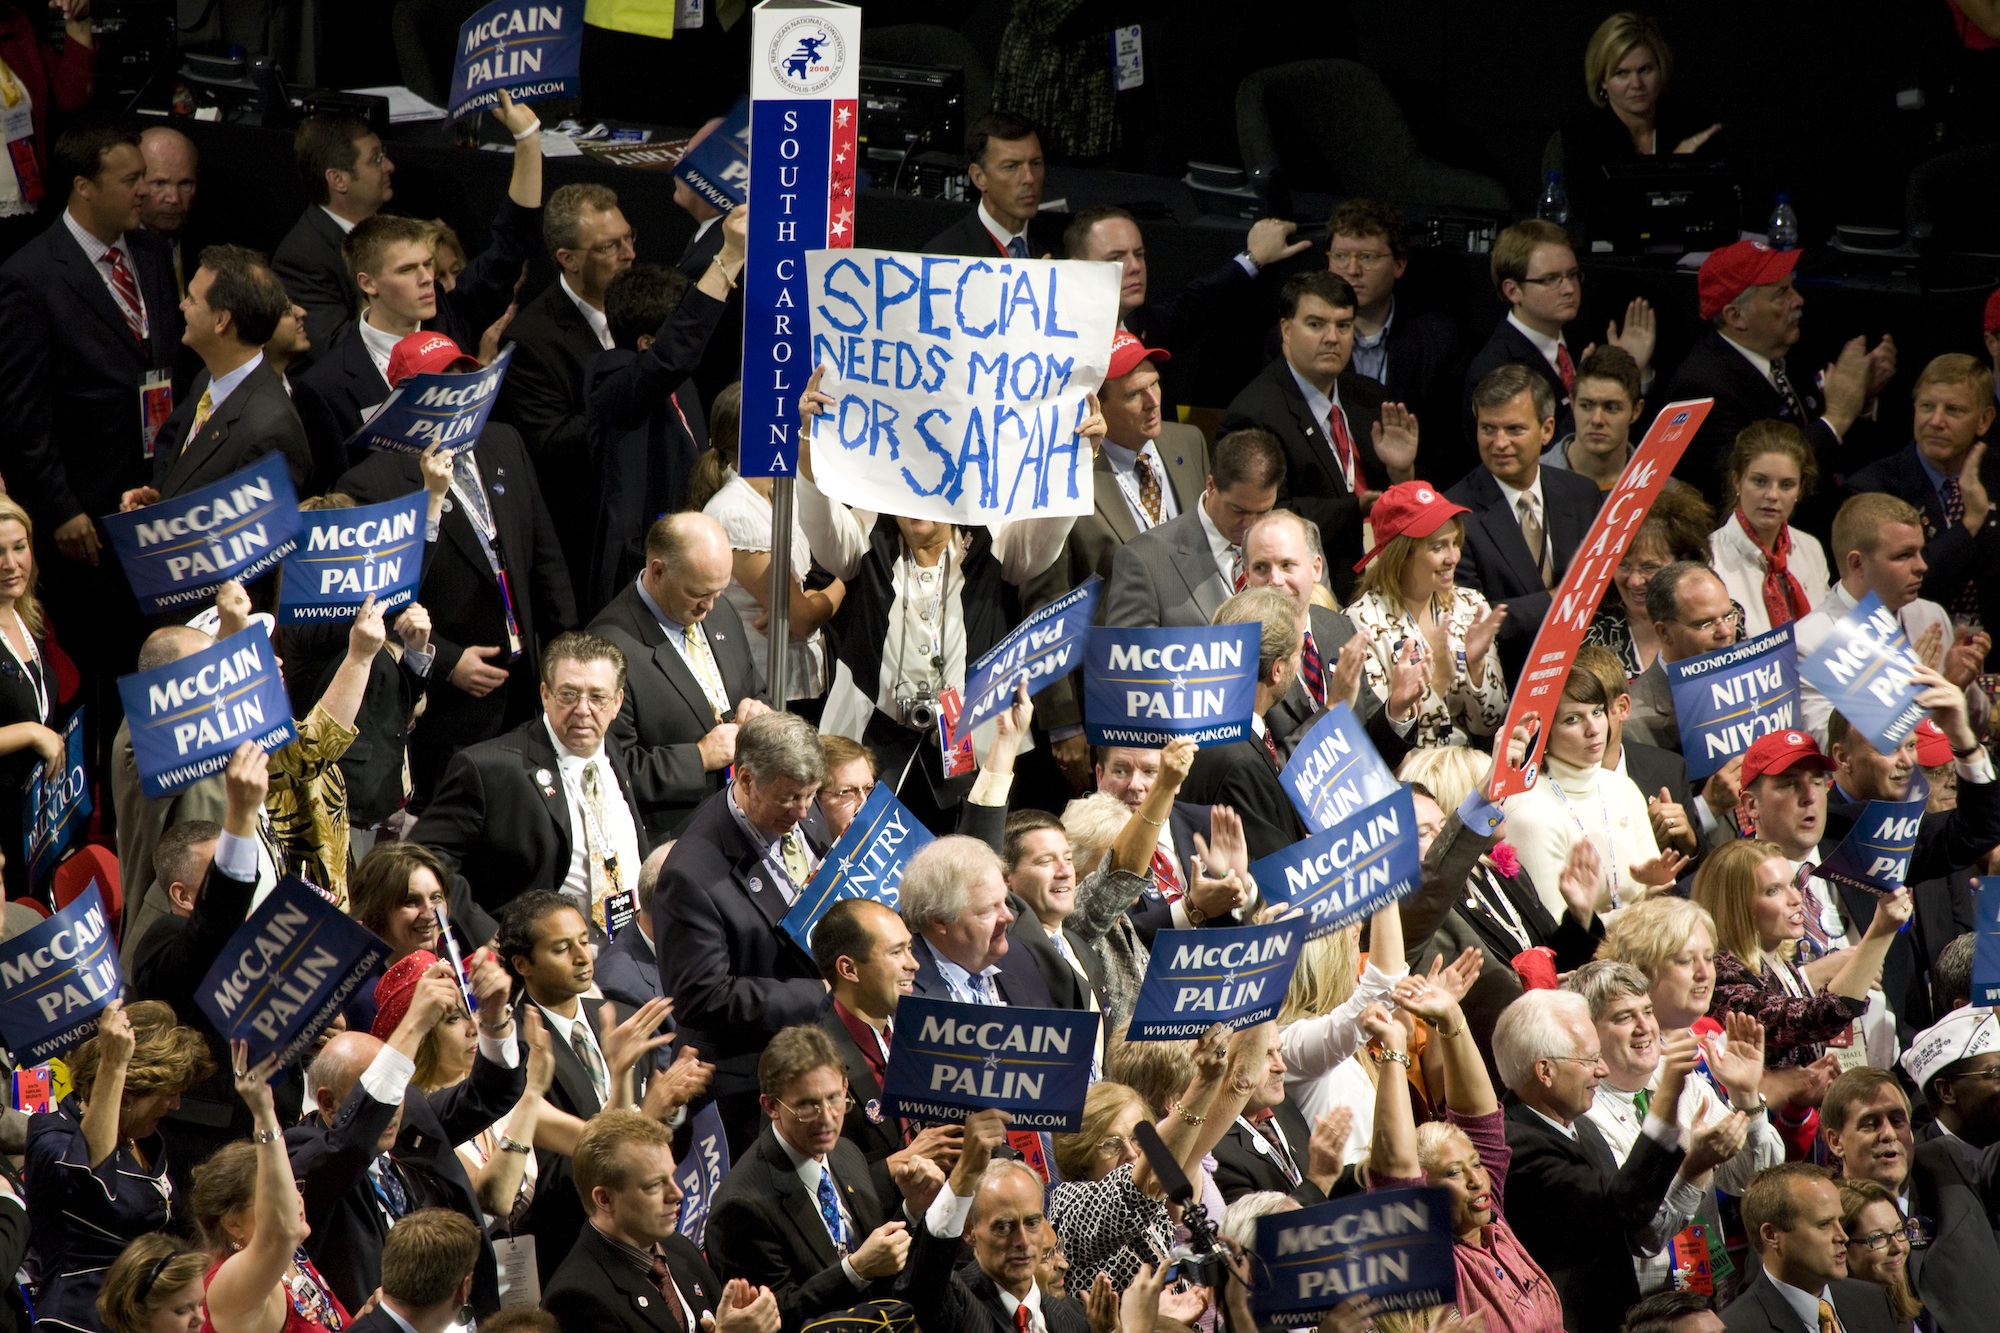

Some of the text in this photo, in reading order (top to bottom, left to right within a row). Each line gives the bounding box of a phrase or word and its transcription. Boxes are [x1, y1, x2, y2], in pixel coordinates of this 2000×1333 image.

[464, 5, 563, 55] McCAIN
[770, 18, 844, 63] REPUBLICAN NATIONAL CONVENTION
[466, 47, 542, 91] PALIN
[829, 66, 841, 81] PAUL
[769, 111, 799, 471] SOUTH CAROLINA
[416, 367, 504, 408] McCAIN
[813, 334, 953, 394] NEEDS
[967, 350, 1075, 401] MOM
[404, 410, 477, 443] PALIN
[134, 475, 275, 549] McCAIN
[306, 508, 417, 554] McCAIN
[165, 521, 269, 582] PALIN
[318, 556, 403, 596] PALIN
[988, 617, 1065, 684] PALIN
[1107, 639, 1243, 673] McCAIN
[148, 642, 264, 716] McCAIN
[1710, 660, 1783, 710] PALIN
[173, 694, 265, 756] PALIN
[1126, 687, 1226, 720] PALIN
[962, 740, 970, 752] 4
[1294, 728, 1352, 806] McCAIN
[1319, 779, 1363, 830] PALIN
[1284, 806, 1401, 896] McCAIN
[610, 894, 630, 910] 2008
[1310, 856, 1391, 924] PALIN
[0, 901, 106, 990] McCAIN
[213, 901, 310, 1019] McCAIN
[1169, 931, 1294, 971] McCAIN
[36, 953, 117, 1024] PALIN
[252, 945, 340, 1042] PALIN
[1173, 977, 1267, 1013] PALIN
[918, 1015, 1073, 1055] McCAIN
[1968, 1030, 1991, 1056] AMVETS
[929, 1063, 1045, 1101] PALIN
[1840, 1061, 1860, 1069] OINS
[38, 1101, 46, 1113] 4
[1031, 1151, 1041, 1165] 4
[1275, 1198, 1429, 1257] McCAIN
[1300, 1250, 1411, 1300] PALIN
[1697, 1260, 1707, 1275] 4
